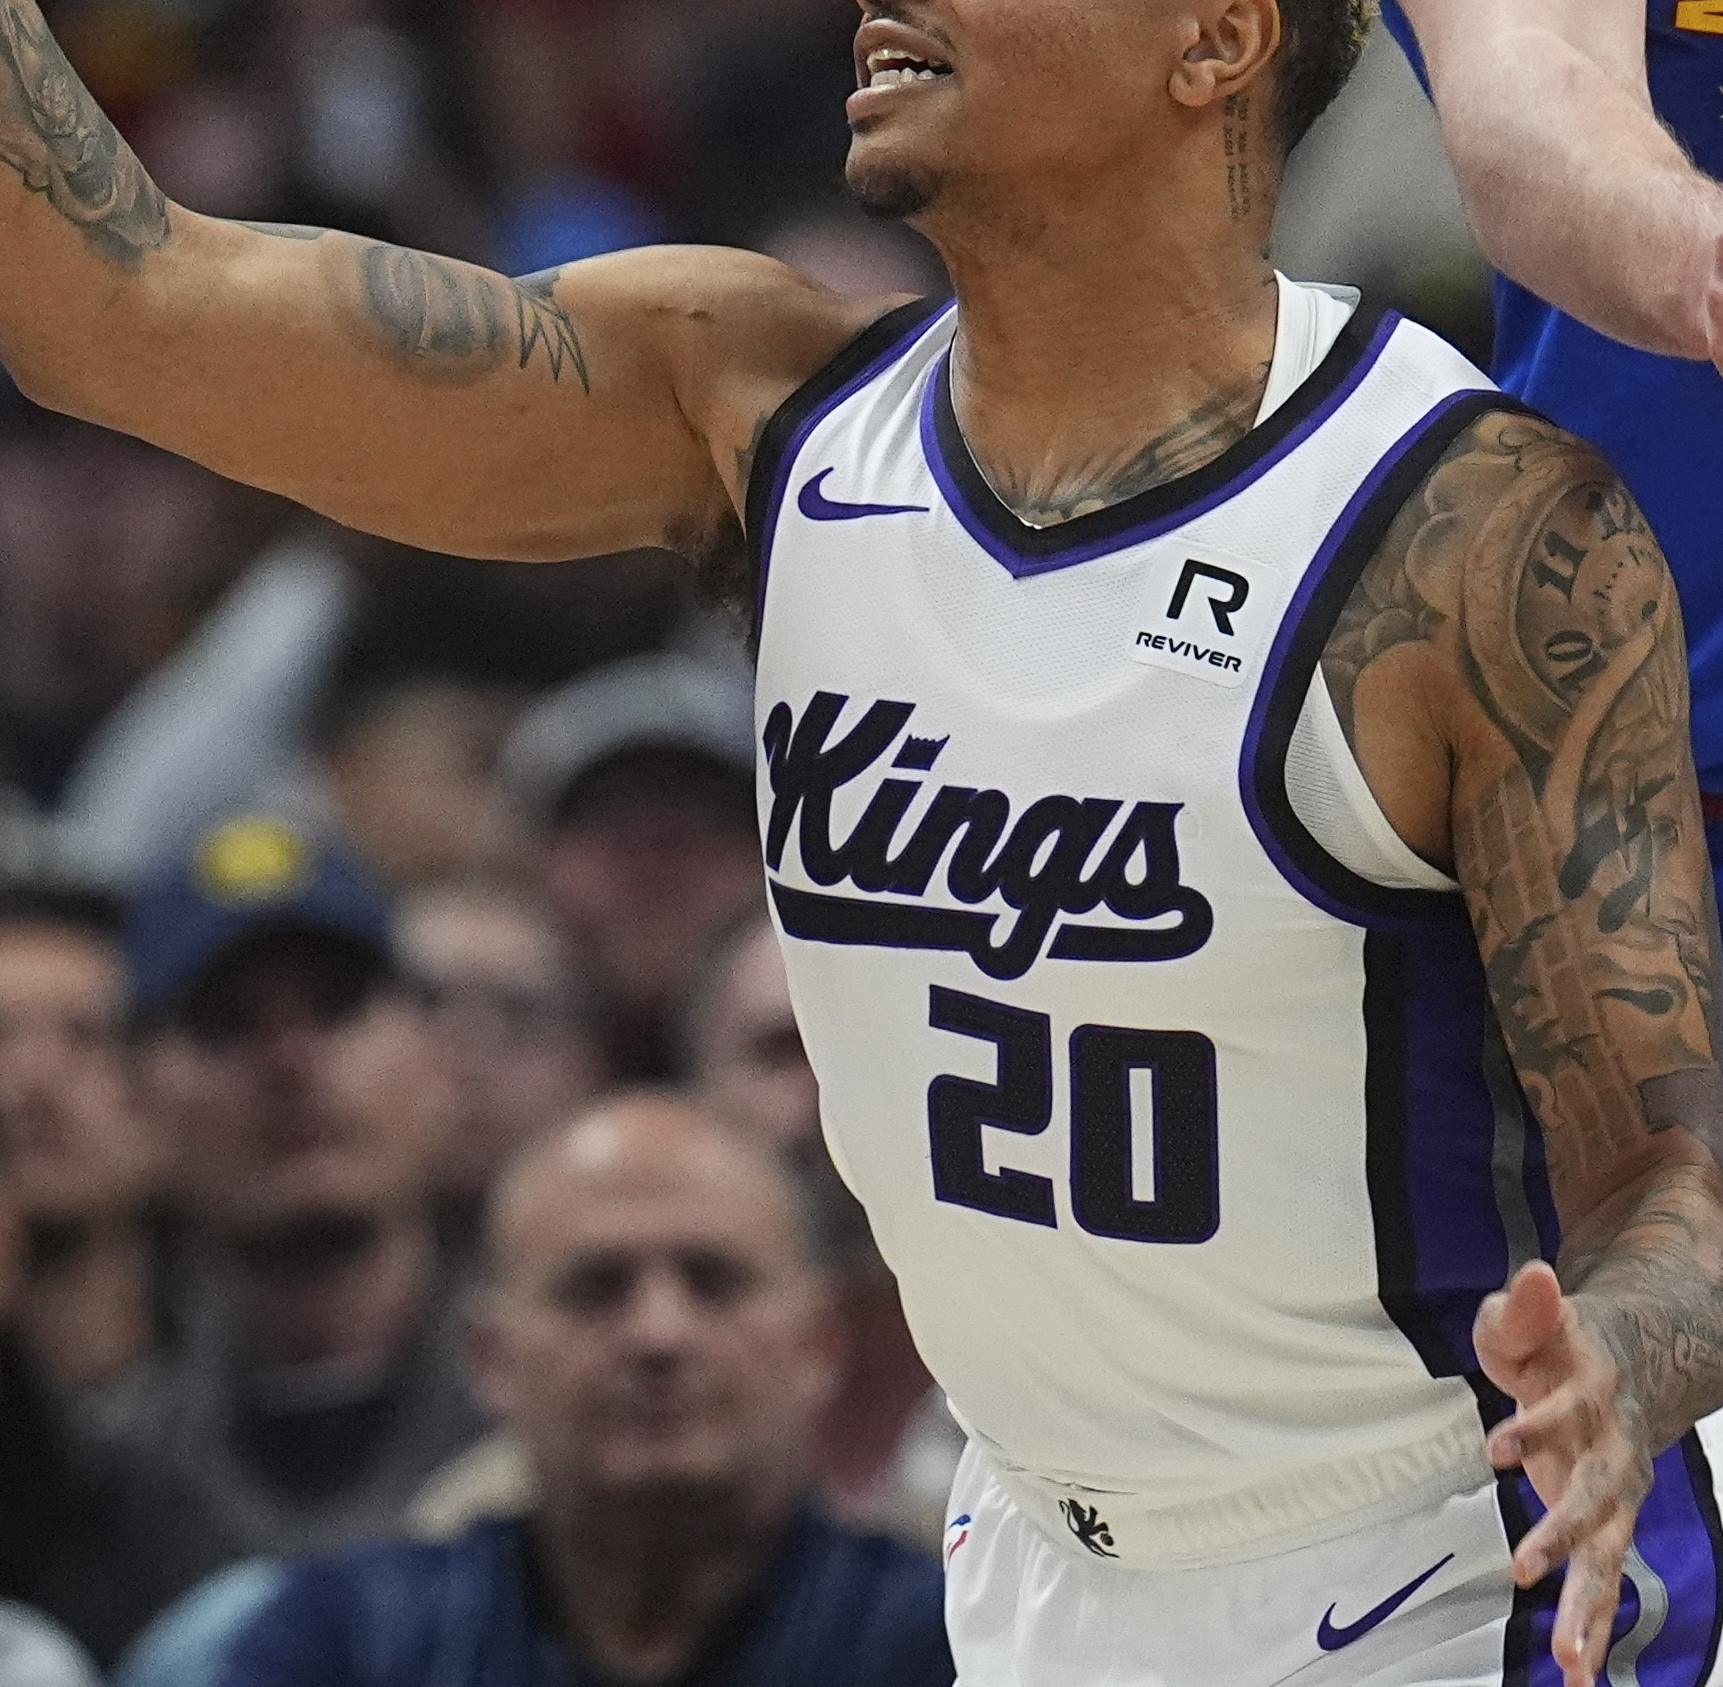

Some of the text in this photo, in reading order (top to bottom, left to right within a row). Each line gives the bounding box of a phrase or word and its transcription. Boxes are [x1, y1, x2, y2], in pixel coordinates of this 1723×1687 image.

[1135, 631, 1243, 673] REVIVER
[1166, 558, 1250, 637] R
[762, 690, 1215, 981] Kings
[927, 984, 1221, 1245] 20
